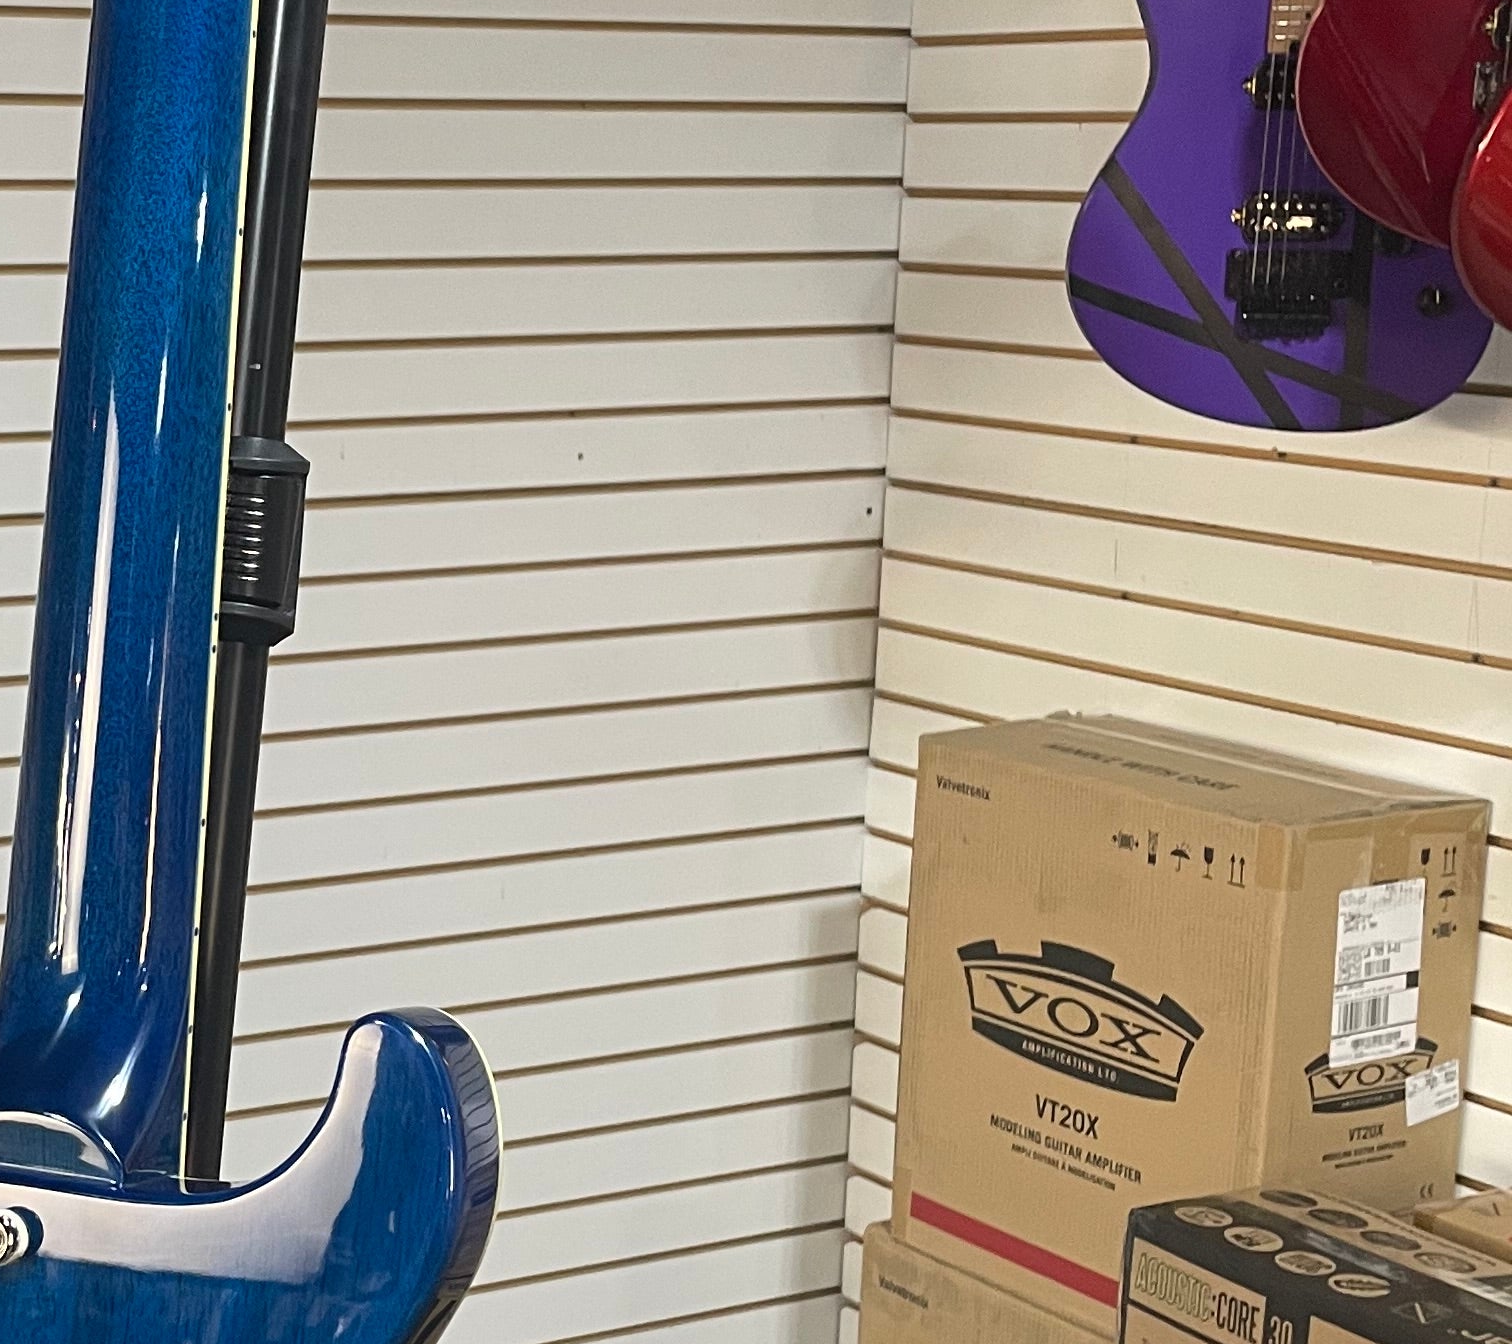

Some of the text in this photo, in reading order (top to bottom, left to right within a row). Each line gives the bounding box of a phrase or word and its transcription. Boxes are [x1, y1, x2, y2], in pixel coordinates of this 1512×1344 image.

[986, 974, 1162, 1063] VOX
[1322, 1058, 1419, 1090] VOX
[1035, 1094, 1100, 1140] VT20X
[1348, 1122, 1385, 1143] VT20X
[1044, 1135, 1083, 1162] GUITAR
[1085, 1151, 1142, 1184] AMPLIFIER
